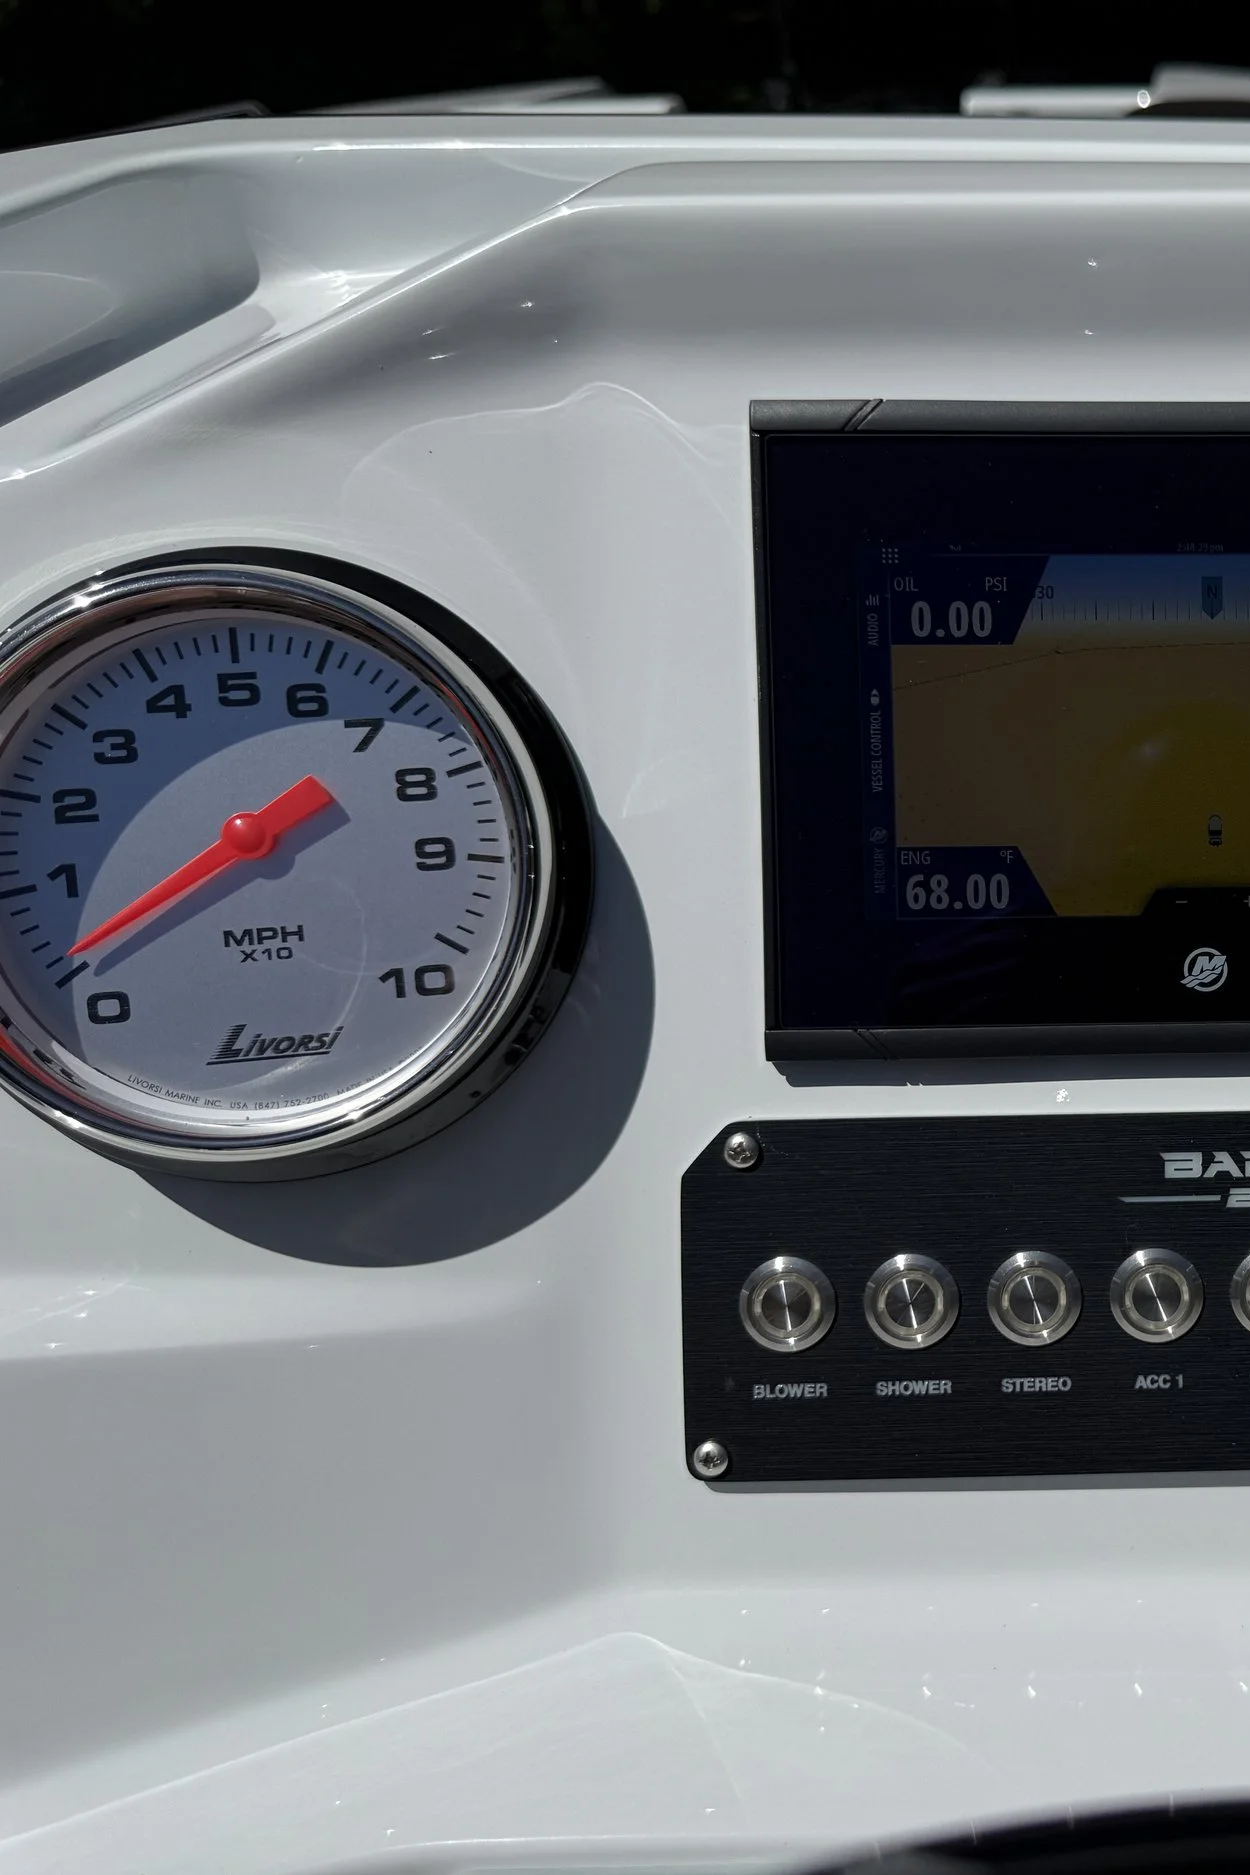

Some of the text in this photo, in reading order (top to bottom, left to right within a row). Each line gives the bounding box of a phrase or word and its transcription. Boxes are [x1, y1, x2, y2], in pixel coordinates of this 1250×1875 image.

[893, 576, 919, 592] OIL
[985, 576, 1008, 592] PSI
[1207, 584, 1218, 599] N
[866, 613, 879, 647] AUDIO
[910, 600, 993, 638] 0.00
[146, 685, 192, 720] 4
[216, 672, 261, 708] 5
[286, 683, 329, 718] 6
[92, 728, 139, 765] 3
[344, 718, 389, 753] 7
[869, 710, 884, 793] VESSEL CONTROL
[394, 767, 437, 802] 8
[52, 788, 100, 825] 2
[414, 836, 456, 872] 9
[872, 847, 887, 895] MERCURY
[900, 850, 931, 866] ENG
[46, 863, 79, 899] 1
[905, 873, 1010, 911] 68.00
[223, 924, 305, 948] MPH
[239, 946, 293, 964] X10
[378, 963, 455, 999] 10
[86, 990, 131, 1025] 0
[127, 1074, 162, 1094] LIVORSI
[165, 1089, 200, 1105] MARINE
[230, 1102, 249, 1110] USA
[753, 1382, 828, 1400] BLOWER
[876, 1379, 952, 1396] SHOWER
[1001, 1376, 1072, 1393] STEREO
[1134, 1373, 1184, 1390] ACC 1
